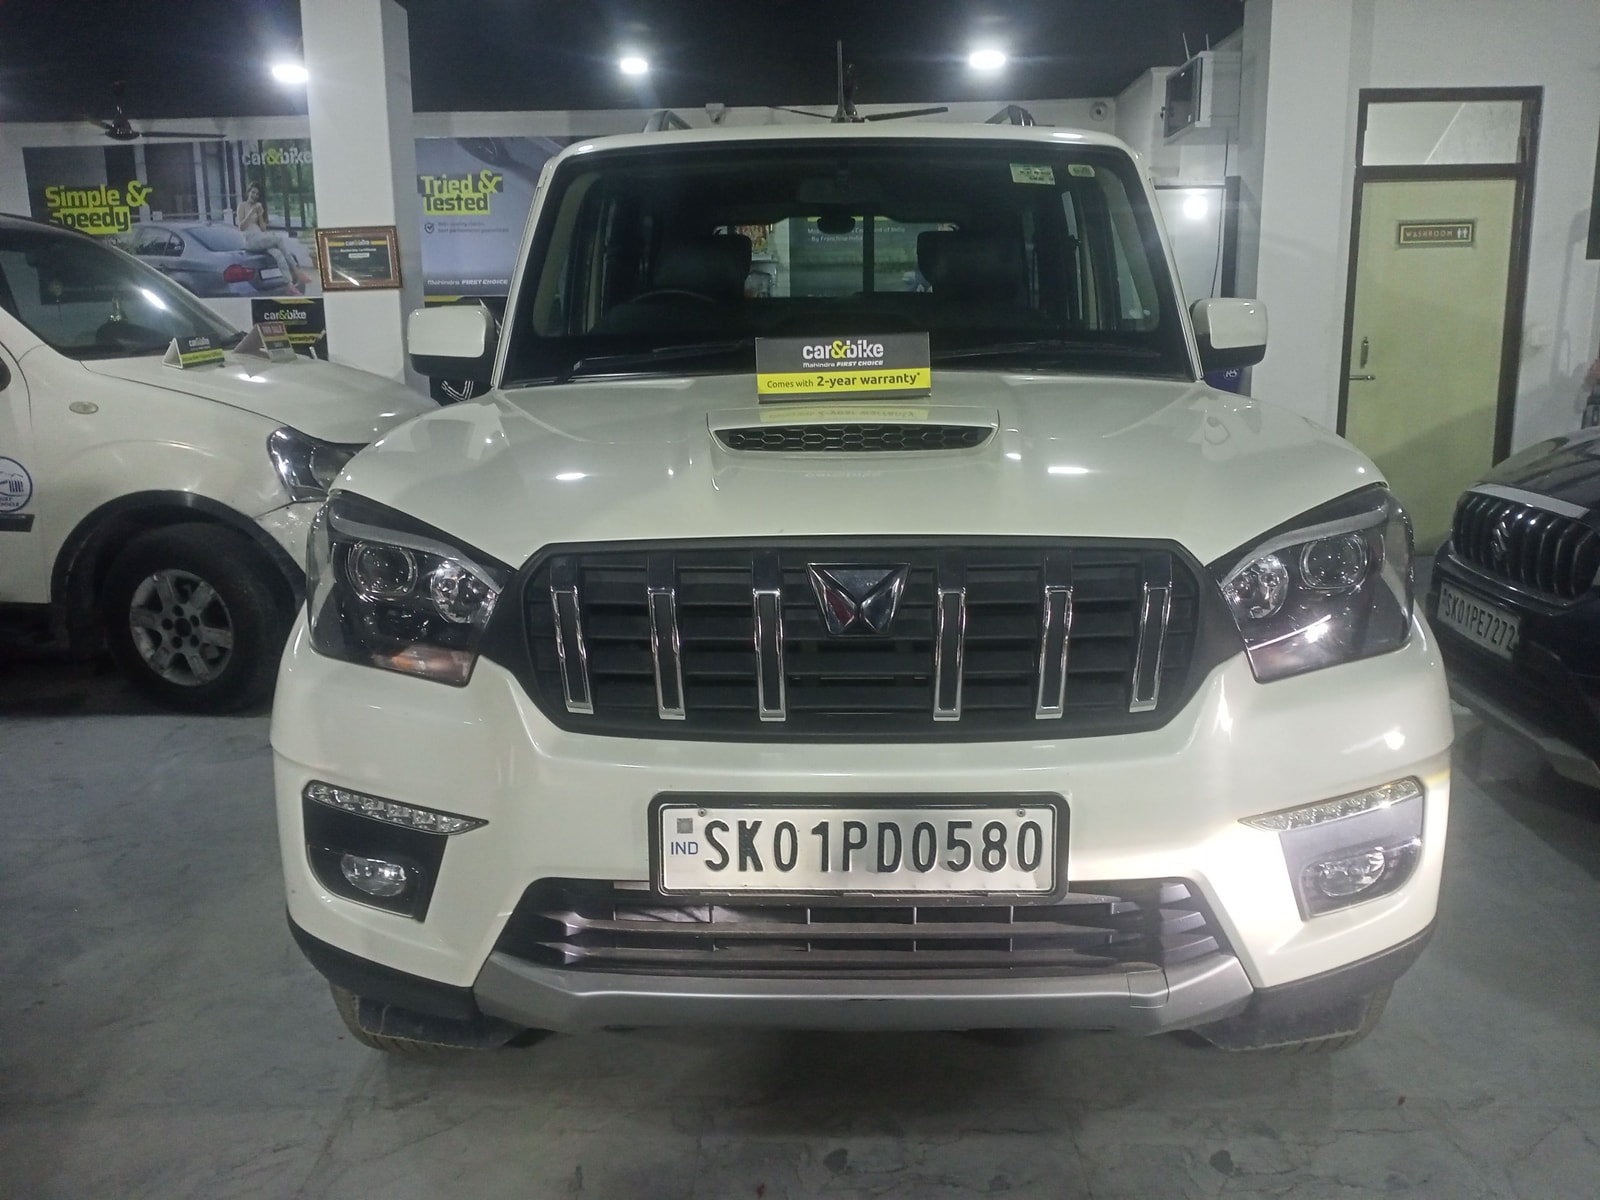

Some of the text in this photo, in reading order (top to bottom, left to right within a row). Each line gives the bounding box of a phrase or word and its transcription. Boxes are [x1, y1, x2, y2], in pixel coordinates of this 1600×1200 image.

[242, 146, 313, 166] car&bike
[420, 168, 503, 195] Tried &
[45, 180, 153, 208] Simple &
[422, 193, 489, 212] Tested
[49, 207, 130, 232] Speedy
[1405, 230, 1453, 238] WASHROOM
[264, 309, 307, 320] car&bike
[802, 339, 884, 360] car&bike
[767, 379, 794, 389] Comes
[796, 378, 814, 388] with
[816, 375, 858, 388] 2-year
[1444, 593, 1516, 651] SK01PE7272
[670, 820, 1043, 873] IND SK01PD0580
